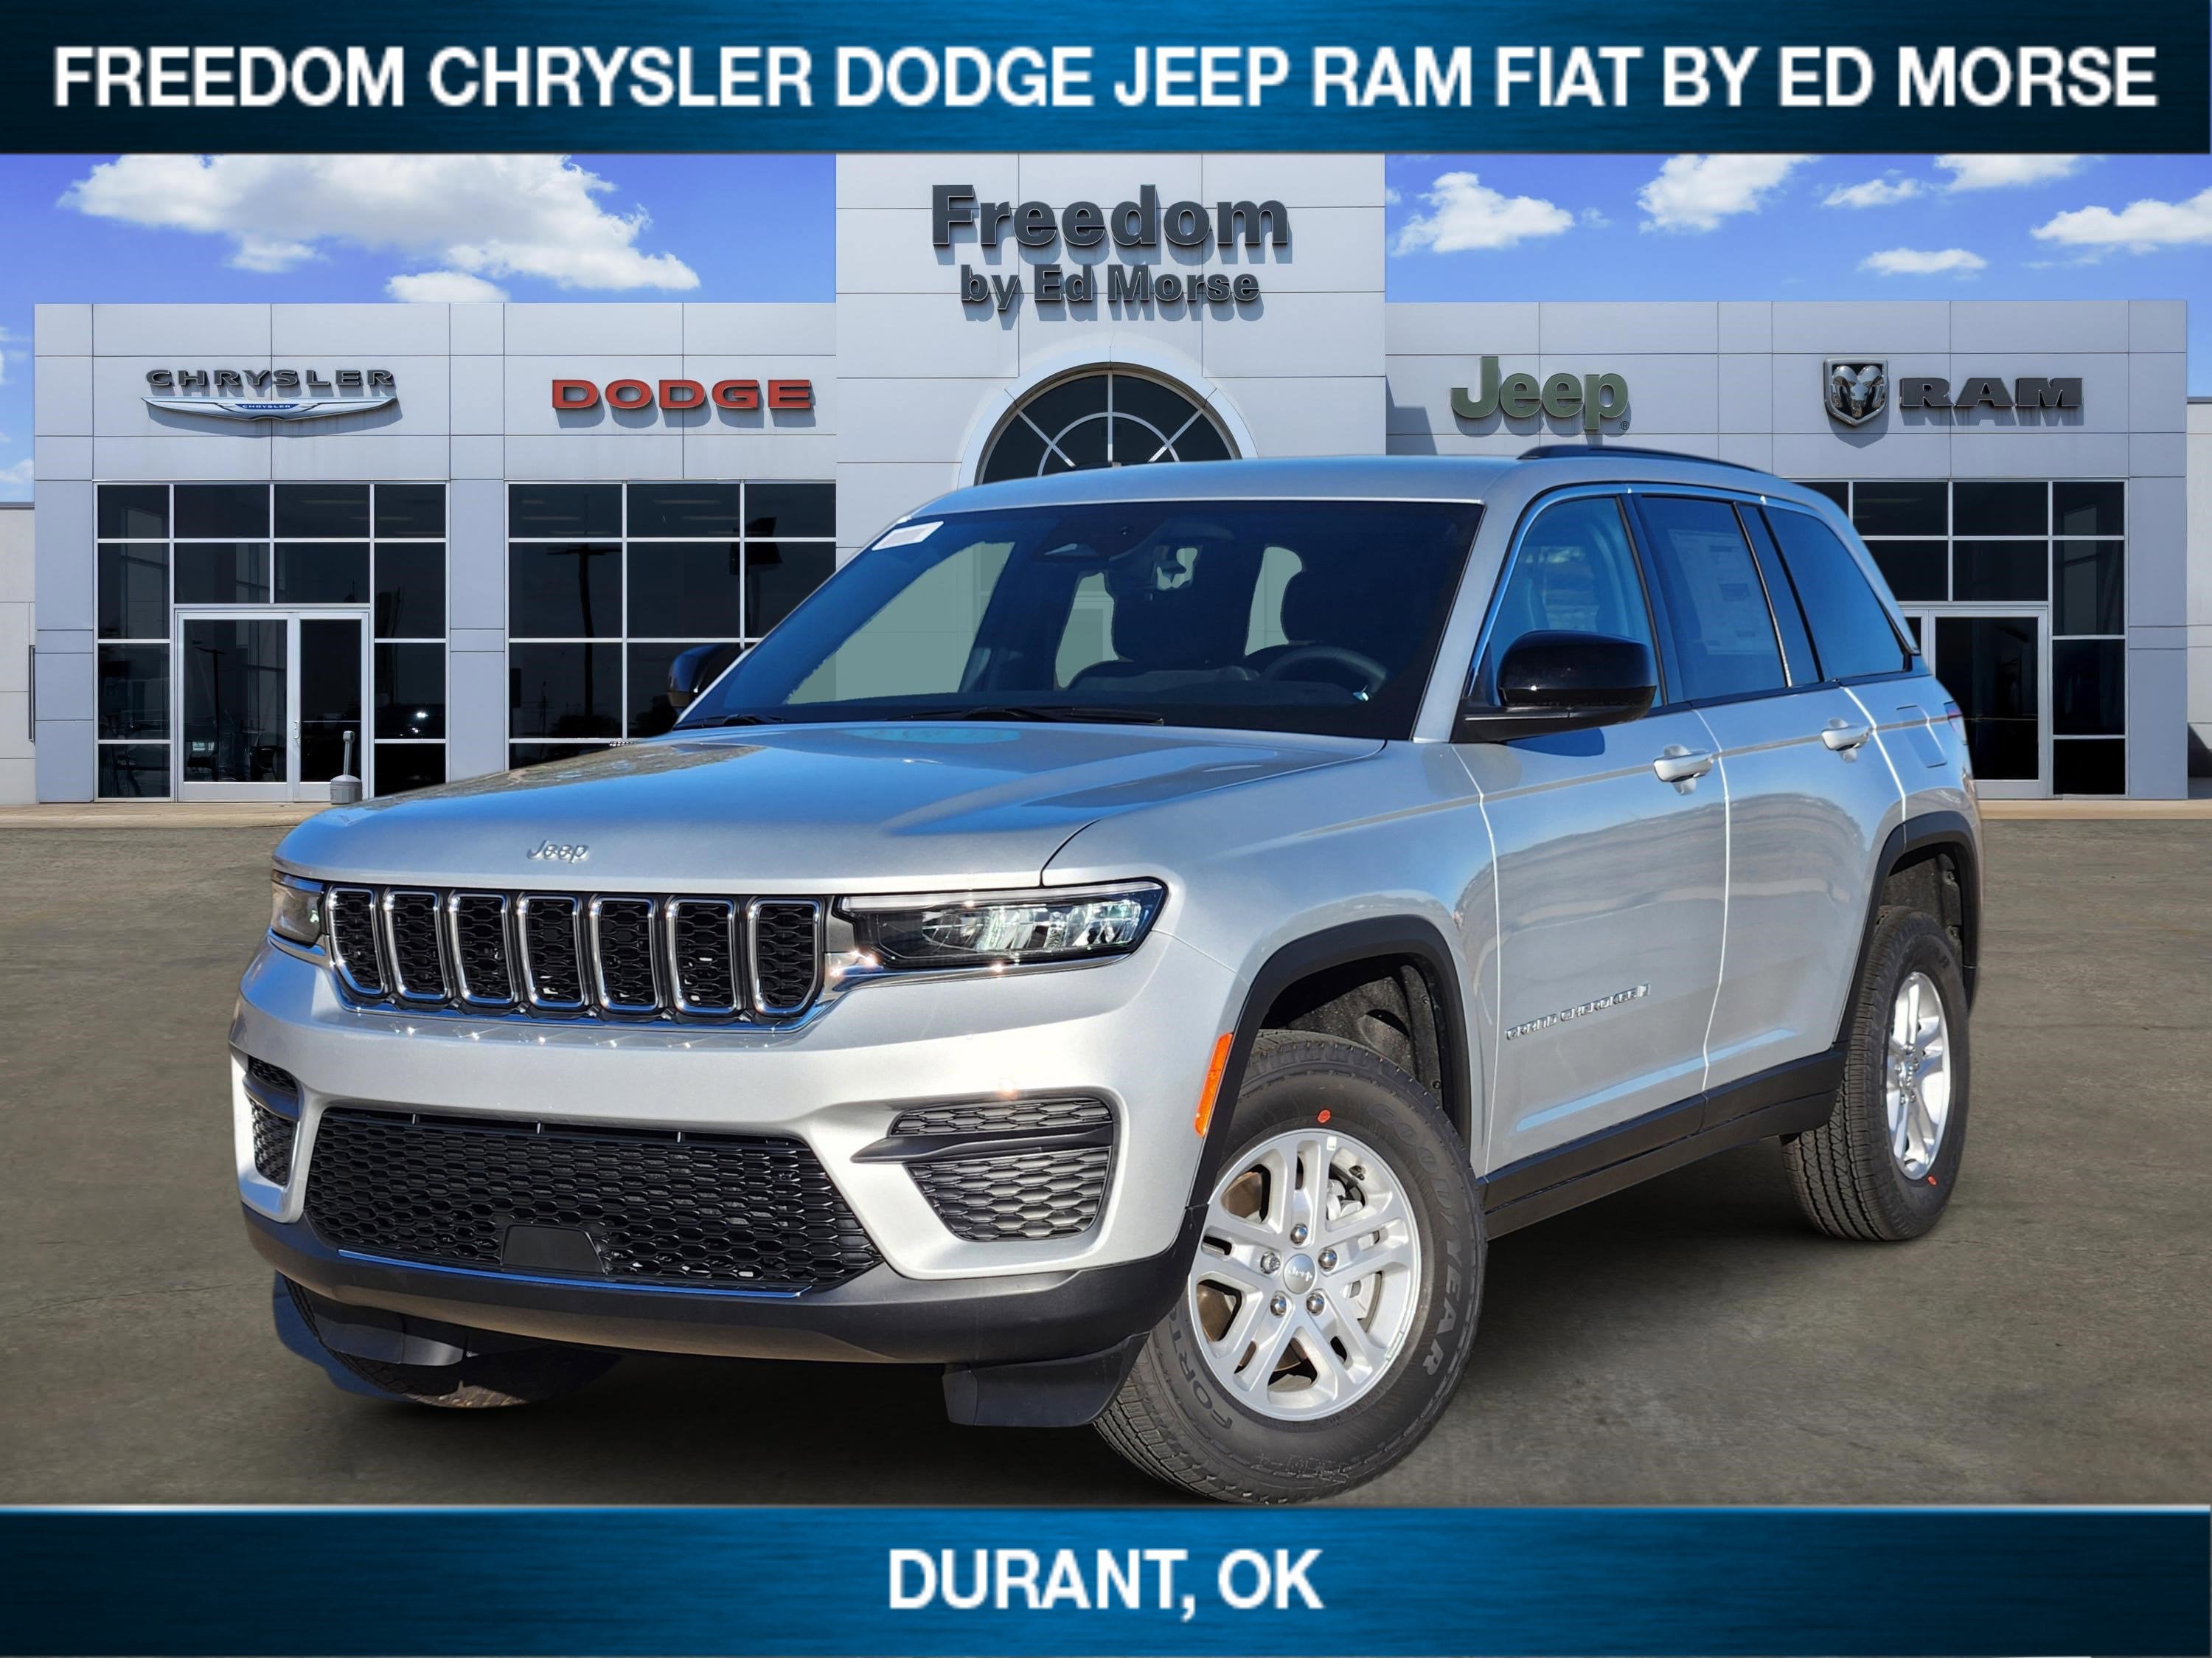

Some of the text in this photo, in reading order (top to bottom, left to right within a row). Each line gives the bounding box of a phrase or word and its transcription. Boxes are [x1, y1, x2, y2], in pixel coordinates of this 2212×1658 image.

[932, 184, 1289, 246] Freedom
[961, 264, 1260, 311] by Ed Morse
[145, 369, 394, 386] CHRYSLER
[552, 379, 812, 409] DODGE
[1450, 356, 1629, 430] Jeep
[1899, 377, 2084, 407] RAM
[526, 839, 589, 864] Jeep
[1368, 1103, 1462, 1377] GOODYEAR
